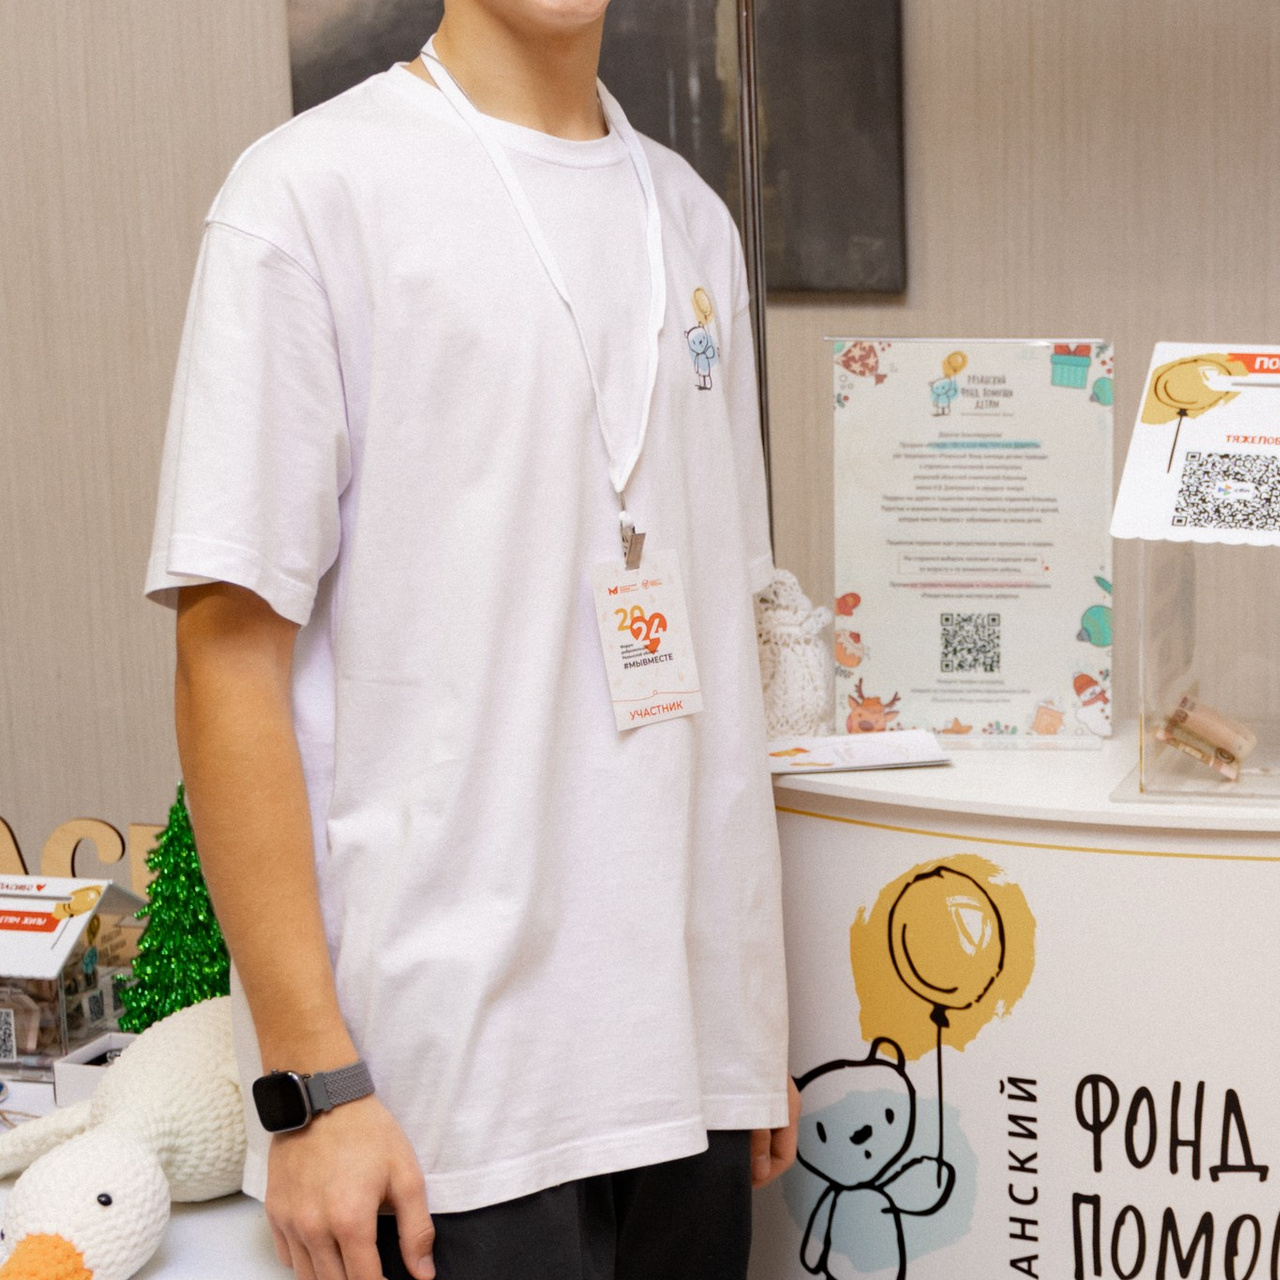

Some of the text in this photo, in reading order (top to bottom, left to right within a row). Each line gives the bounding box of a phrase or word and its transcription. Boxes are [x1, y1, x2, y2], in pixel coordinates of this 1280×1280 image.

[623, 652, 674, 670] #МЫВМЕСТЕ
[630, 700, 683, 721] УЧАСТНИК
[1073, 1072, 1270, 1183] ФОНД
